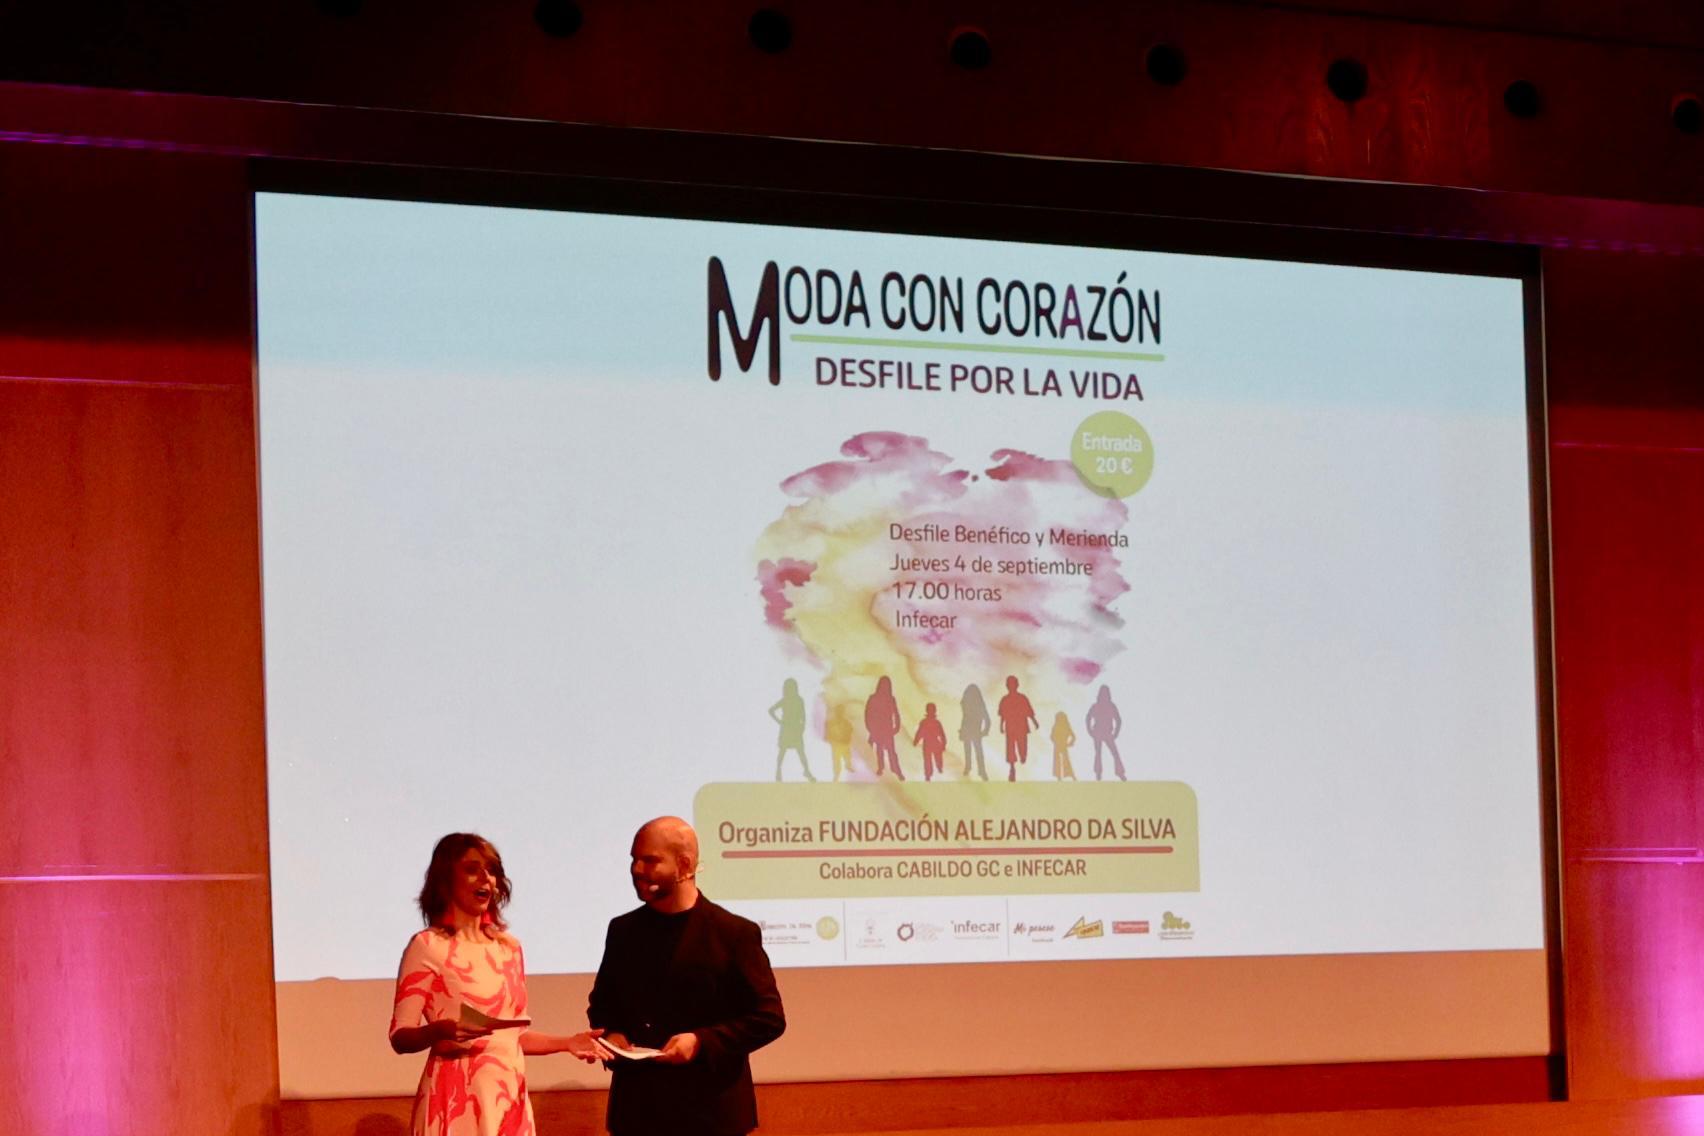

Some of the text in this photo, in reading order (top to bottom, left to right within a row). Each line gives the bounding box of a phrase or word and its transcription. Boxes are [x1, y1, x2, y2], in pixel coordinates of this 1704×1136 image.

[707, 256, 1161, 386] MODA CON CORAZÓN
[815, 357, 1144, 401] DESFILE POR LA VIDA
[1082, 432, 1142, 453] Entrada
[1096, 458, 1133, 476] 20 €
[889, 522, 1129, 549] Desfile Benéfico y Merienda
[889, 553, 1094, 577] Jueves 4 de septiembre
[892, 581, 1002, 602] 17.00 horas
[896, 609, 958, 629] Infecar
[718, 813, 1176, 848] Organiza FUNDACIÓN ALEJANDRO DA SILVA
[819, 858, 1087, 880] Colabora CABILDO GC e INFECAR
